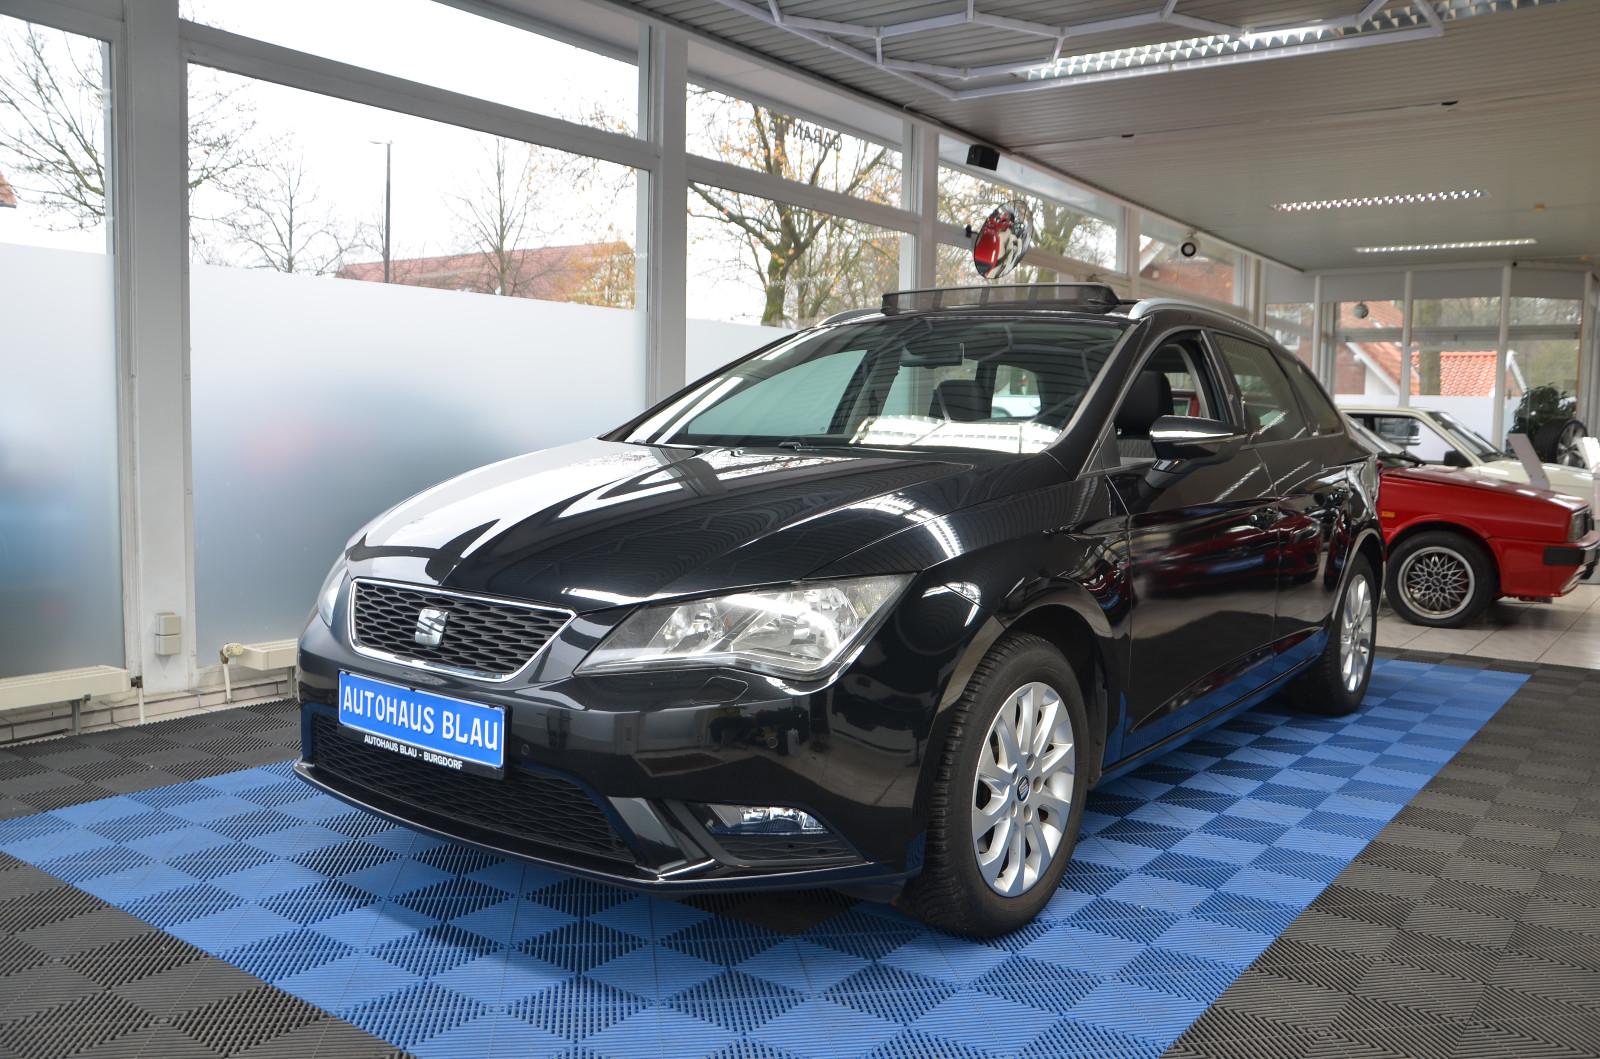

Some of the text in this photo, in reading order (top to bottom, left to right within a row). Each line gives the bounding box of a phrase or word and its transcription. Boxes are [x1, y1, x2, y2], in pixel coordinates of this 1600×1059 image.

[343, 685, 498, 751] AUTOHAUS BLAU
[364, 734, 399, 753] AUTOHAUS
[399, 744, 417, 758] BLAU
[423, 751, 464, 770] BURGDORF
